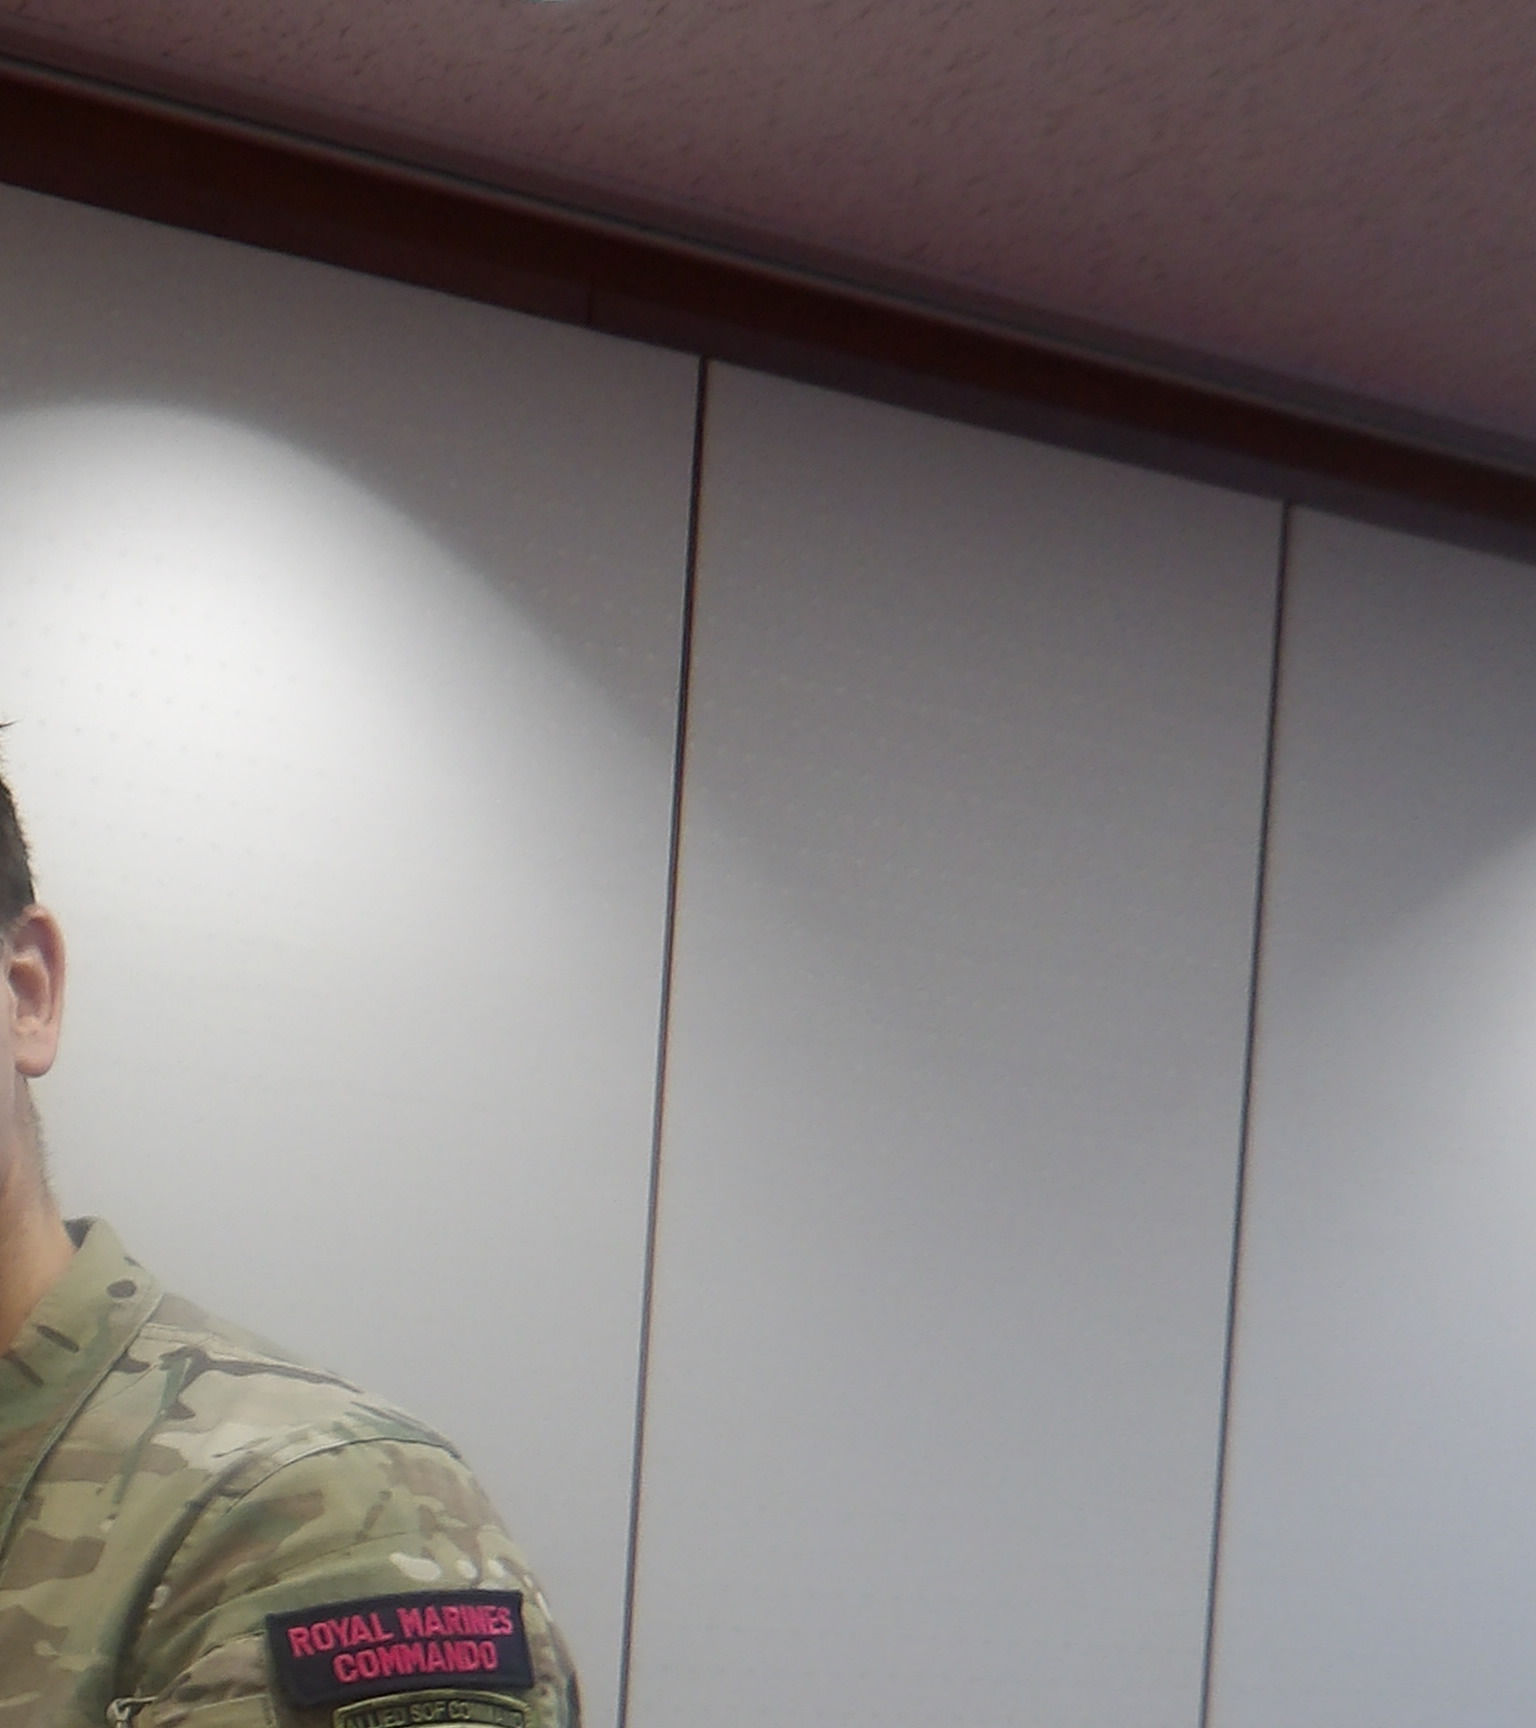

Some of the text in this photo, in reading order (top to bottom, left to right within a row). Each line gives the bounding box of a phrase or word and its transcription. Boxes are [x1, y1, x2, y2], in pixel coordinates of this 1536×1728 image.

[287, 1604, 513, 1658] ROYAL MARINES
[332, 1640, 499, 1684] COMMANDO
[409, 1700, 447, 1723] SOF
